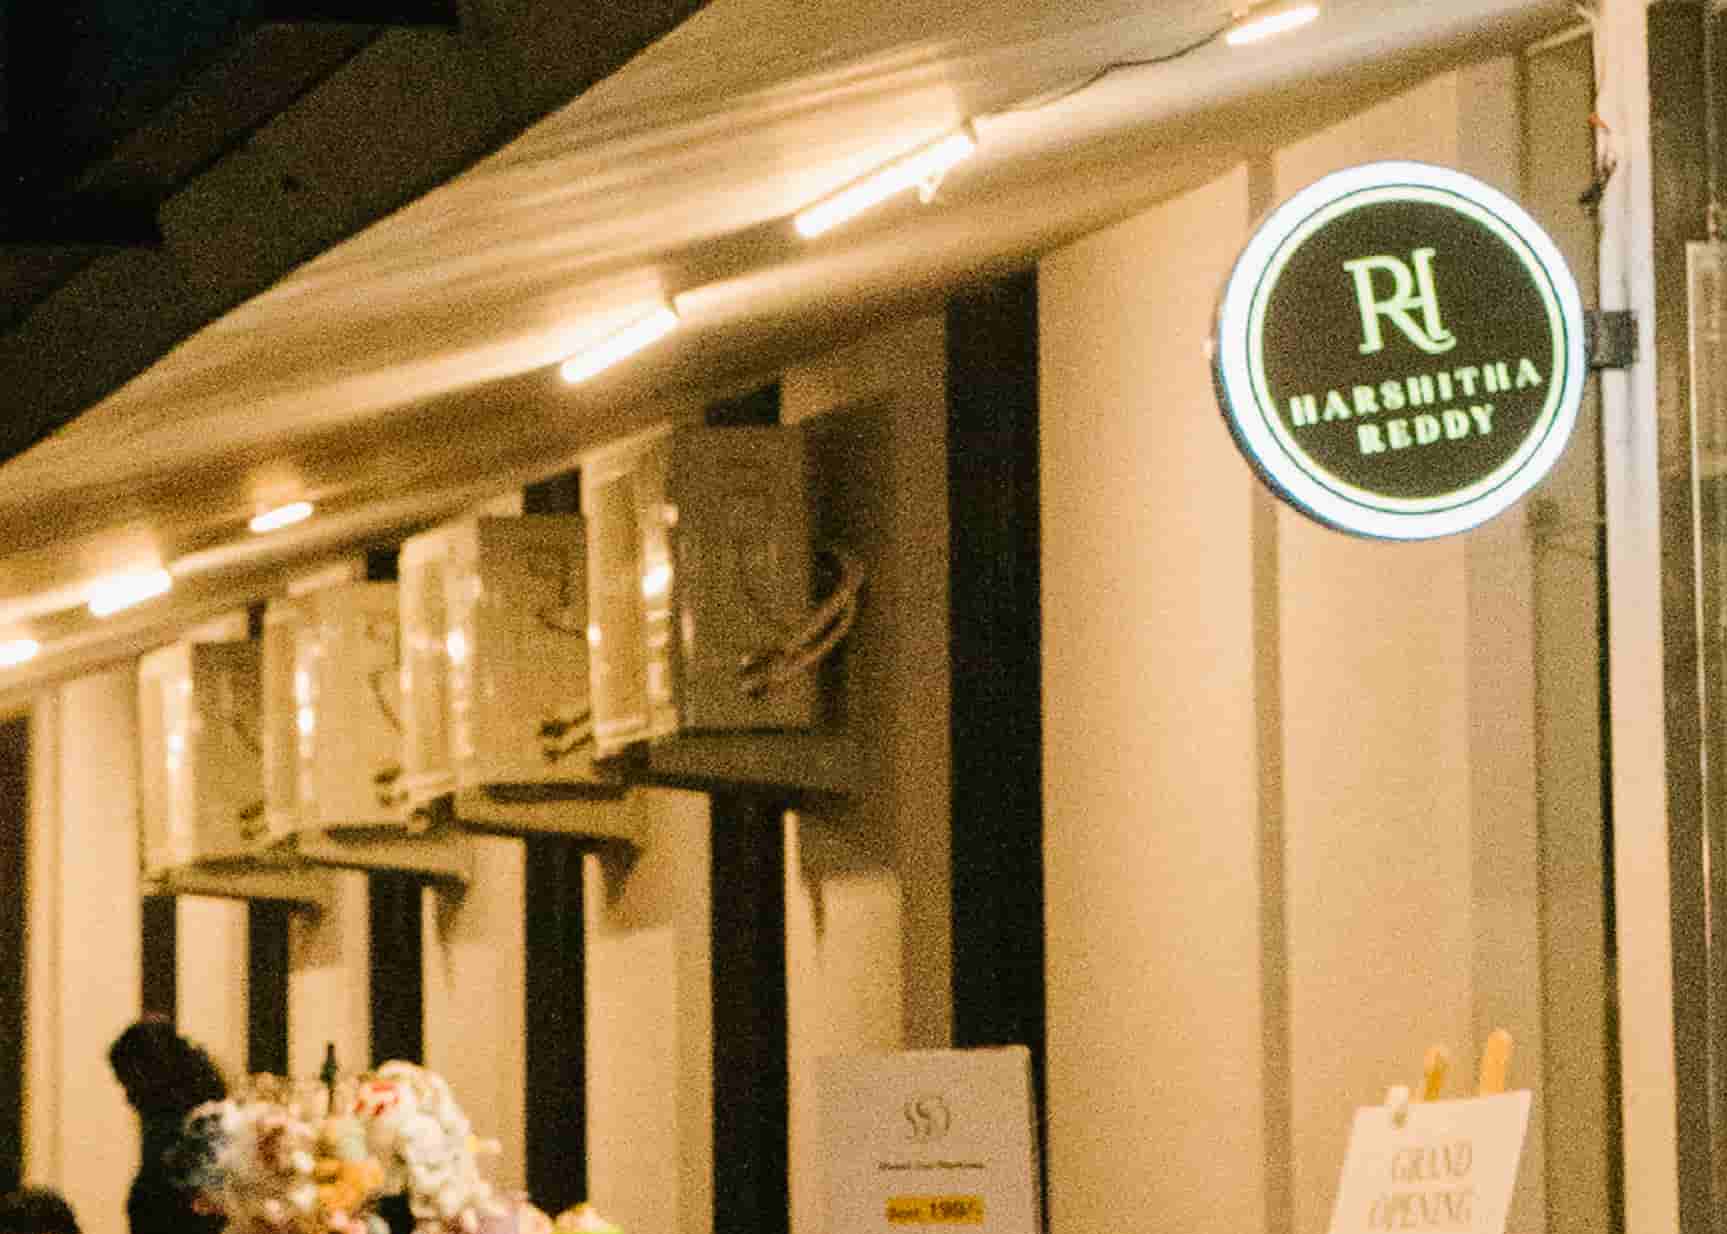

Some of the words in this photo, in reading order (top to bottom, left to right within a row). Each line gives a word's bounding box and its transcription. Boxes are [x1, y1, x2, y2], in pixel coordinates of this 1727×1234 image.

[1289, 358, 1543, 428] HARSHITHA
[1356, 403, 1496, 455] REDDY
[1390, 1143, 1474, 1183] GRAND
[1367, 1190, 1474, 1231] OPENING
